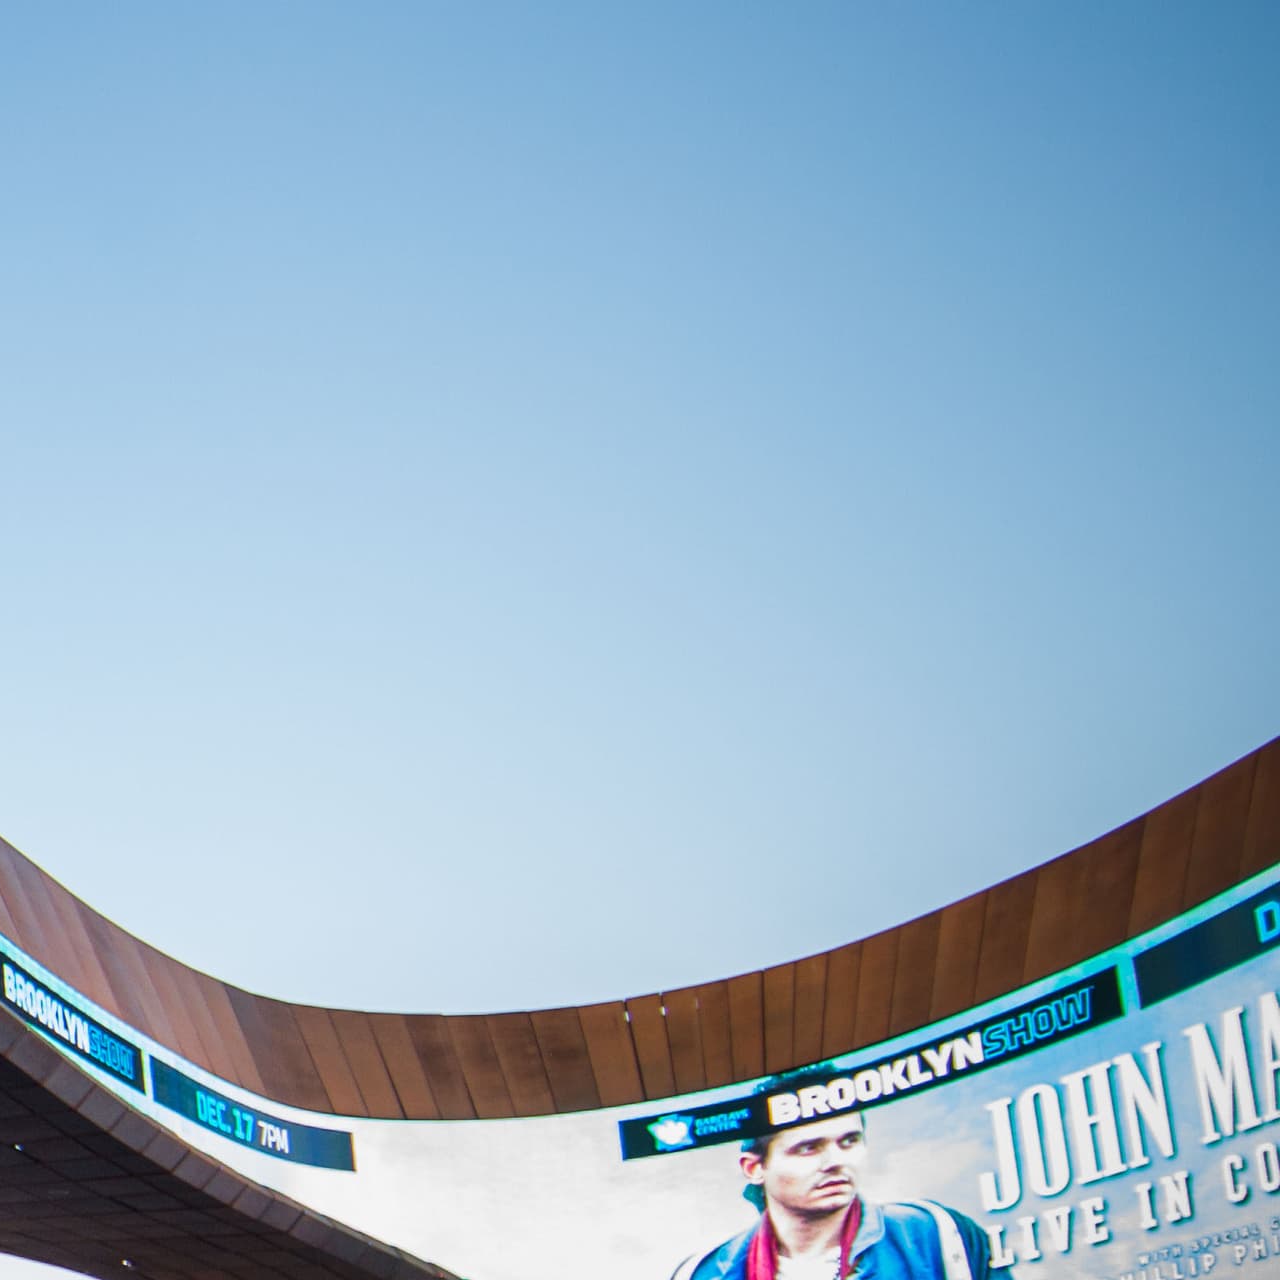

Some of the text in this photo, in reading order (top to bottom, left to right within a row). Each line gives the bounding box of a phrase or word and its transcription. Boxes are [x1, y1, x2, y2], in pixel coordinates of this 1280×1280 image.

[196, 1090, 290, 1154] DEC. 17 7PM
[979, 1041, 1176, 1212] JOHN
[988, 1142, 1280, 1270] LIVE IN CO
[1233, 1233, 1280, 1266] PHI
